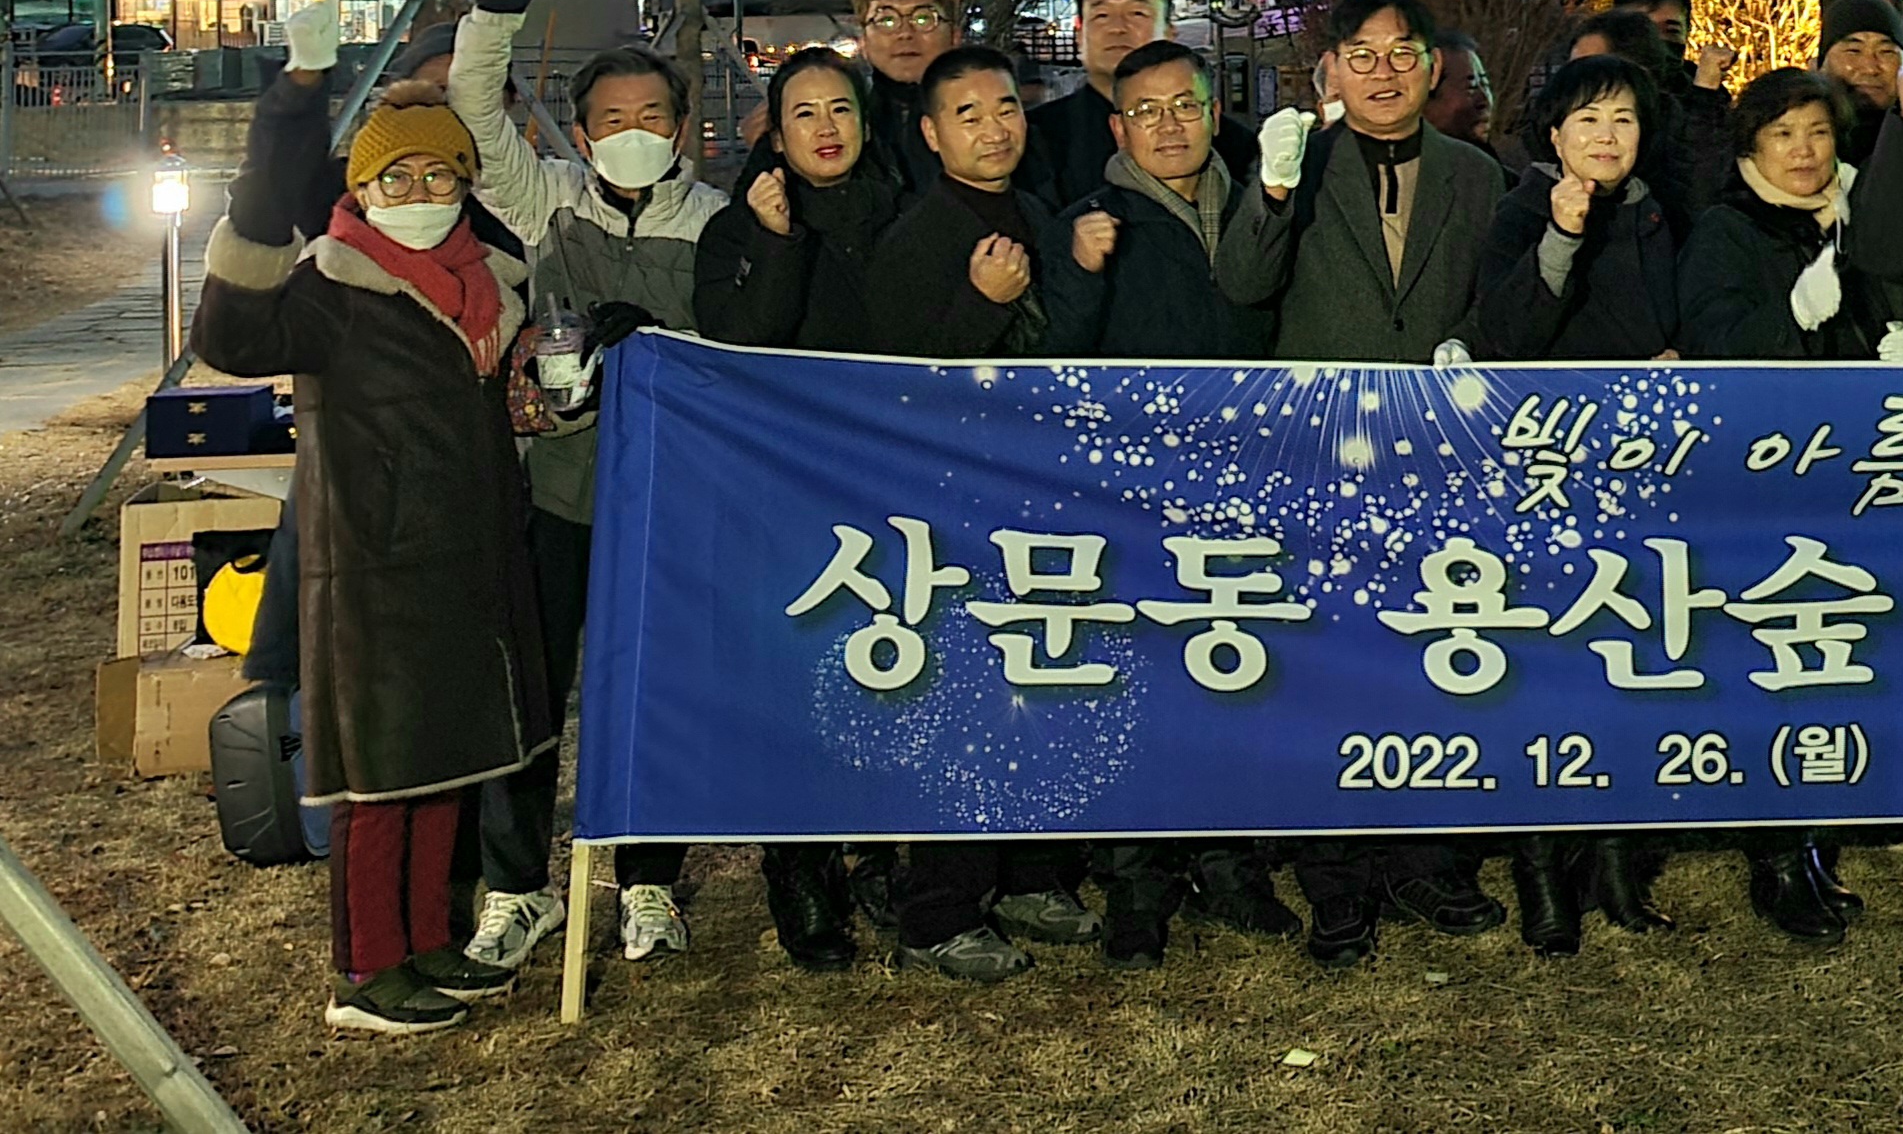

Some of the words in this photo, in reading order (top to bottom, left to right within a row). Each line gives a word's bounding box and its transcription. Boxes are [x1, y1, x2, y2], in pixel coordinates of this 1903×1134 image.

[1500, 393, 1701, 513] 빛이
[785, 515, 1313, 692] 상문동
[1376, 534, 1895, 696] 용산숲
[1337, 732, 1499, 791] 2022.
[1525, 733, 1612, 789] 12.
[1655, 730, 1745, 787] 26.
[1770, 723, 1871, 787] (월)
